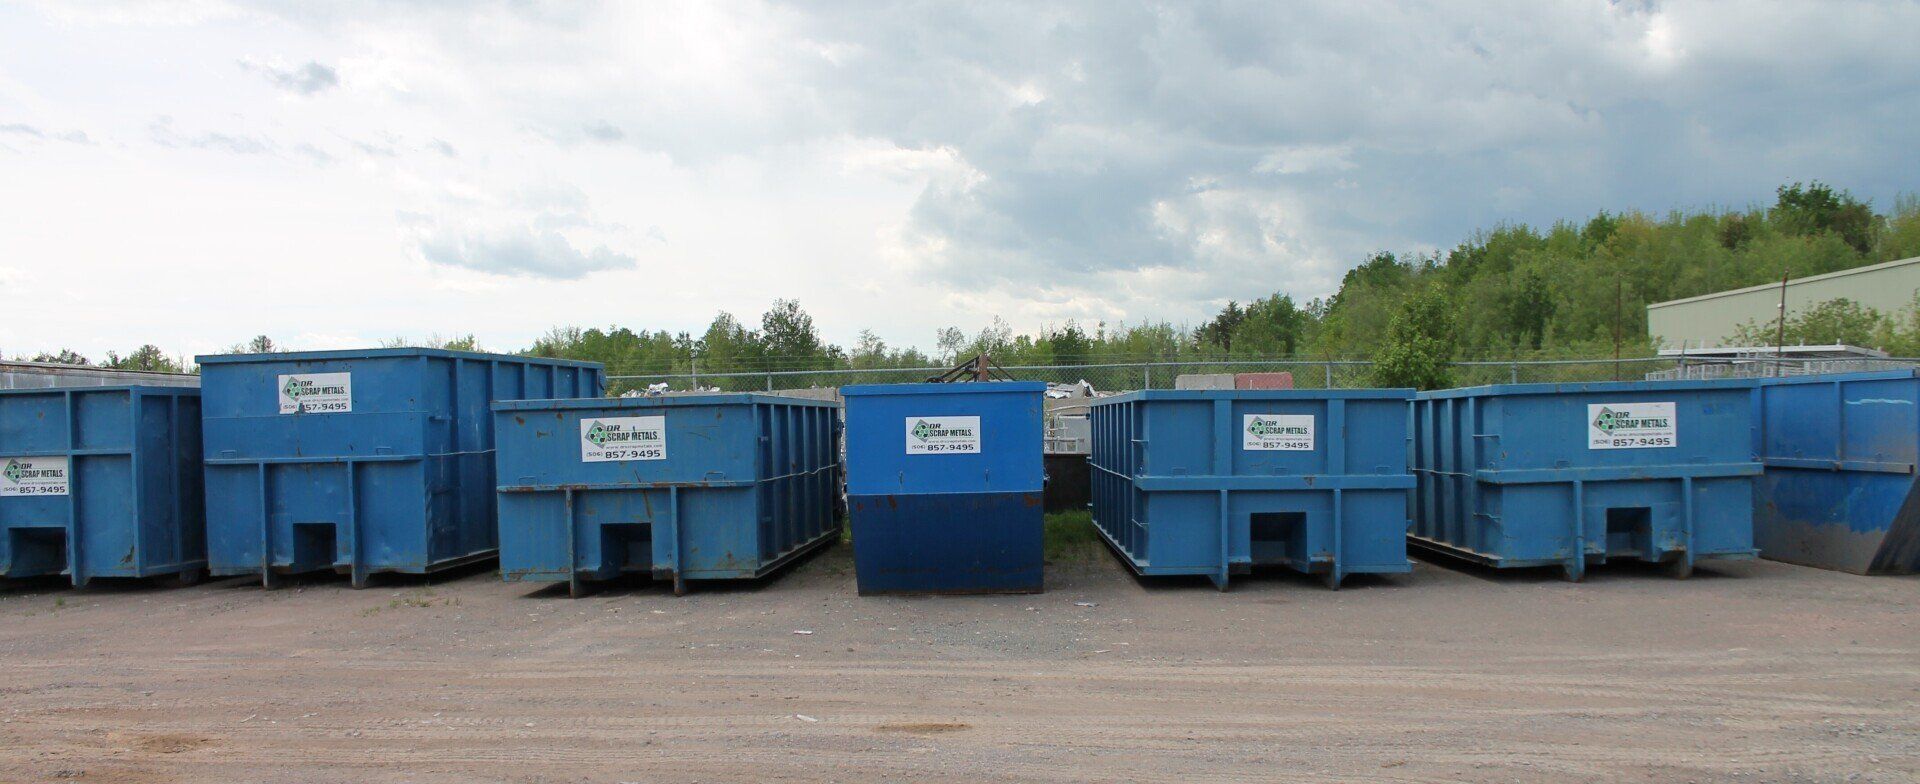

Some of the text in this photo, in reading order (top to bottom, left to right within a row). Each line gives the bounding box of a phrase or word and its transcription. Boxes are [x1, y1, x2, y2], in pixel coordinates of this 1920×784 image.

[301, 387, 320, 395] SCRAP
[1616, 419, 1668, 428] SCRAP METALS
[607, 431, 658, 441] SCRAP METALS
[1613, 438, 1670, 446] 857-9495
[606, 450, 661, 459] 857-9495
[21, 469, 63, 478] SCRAP METALS
